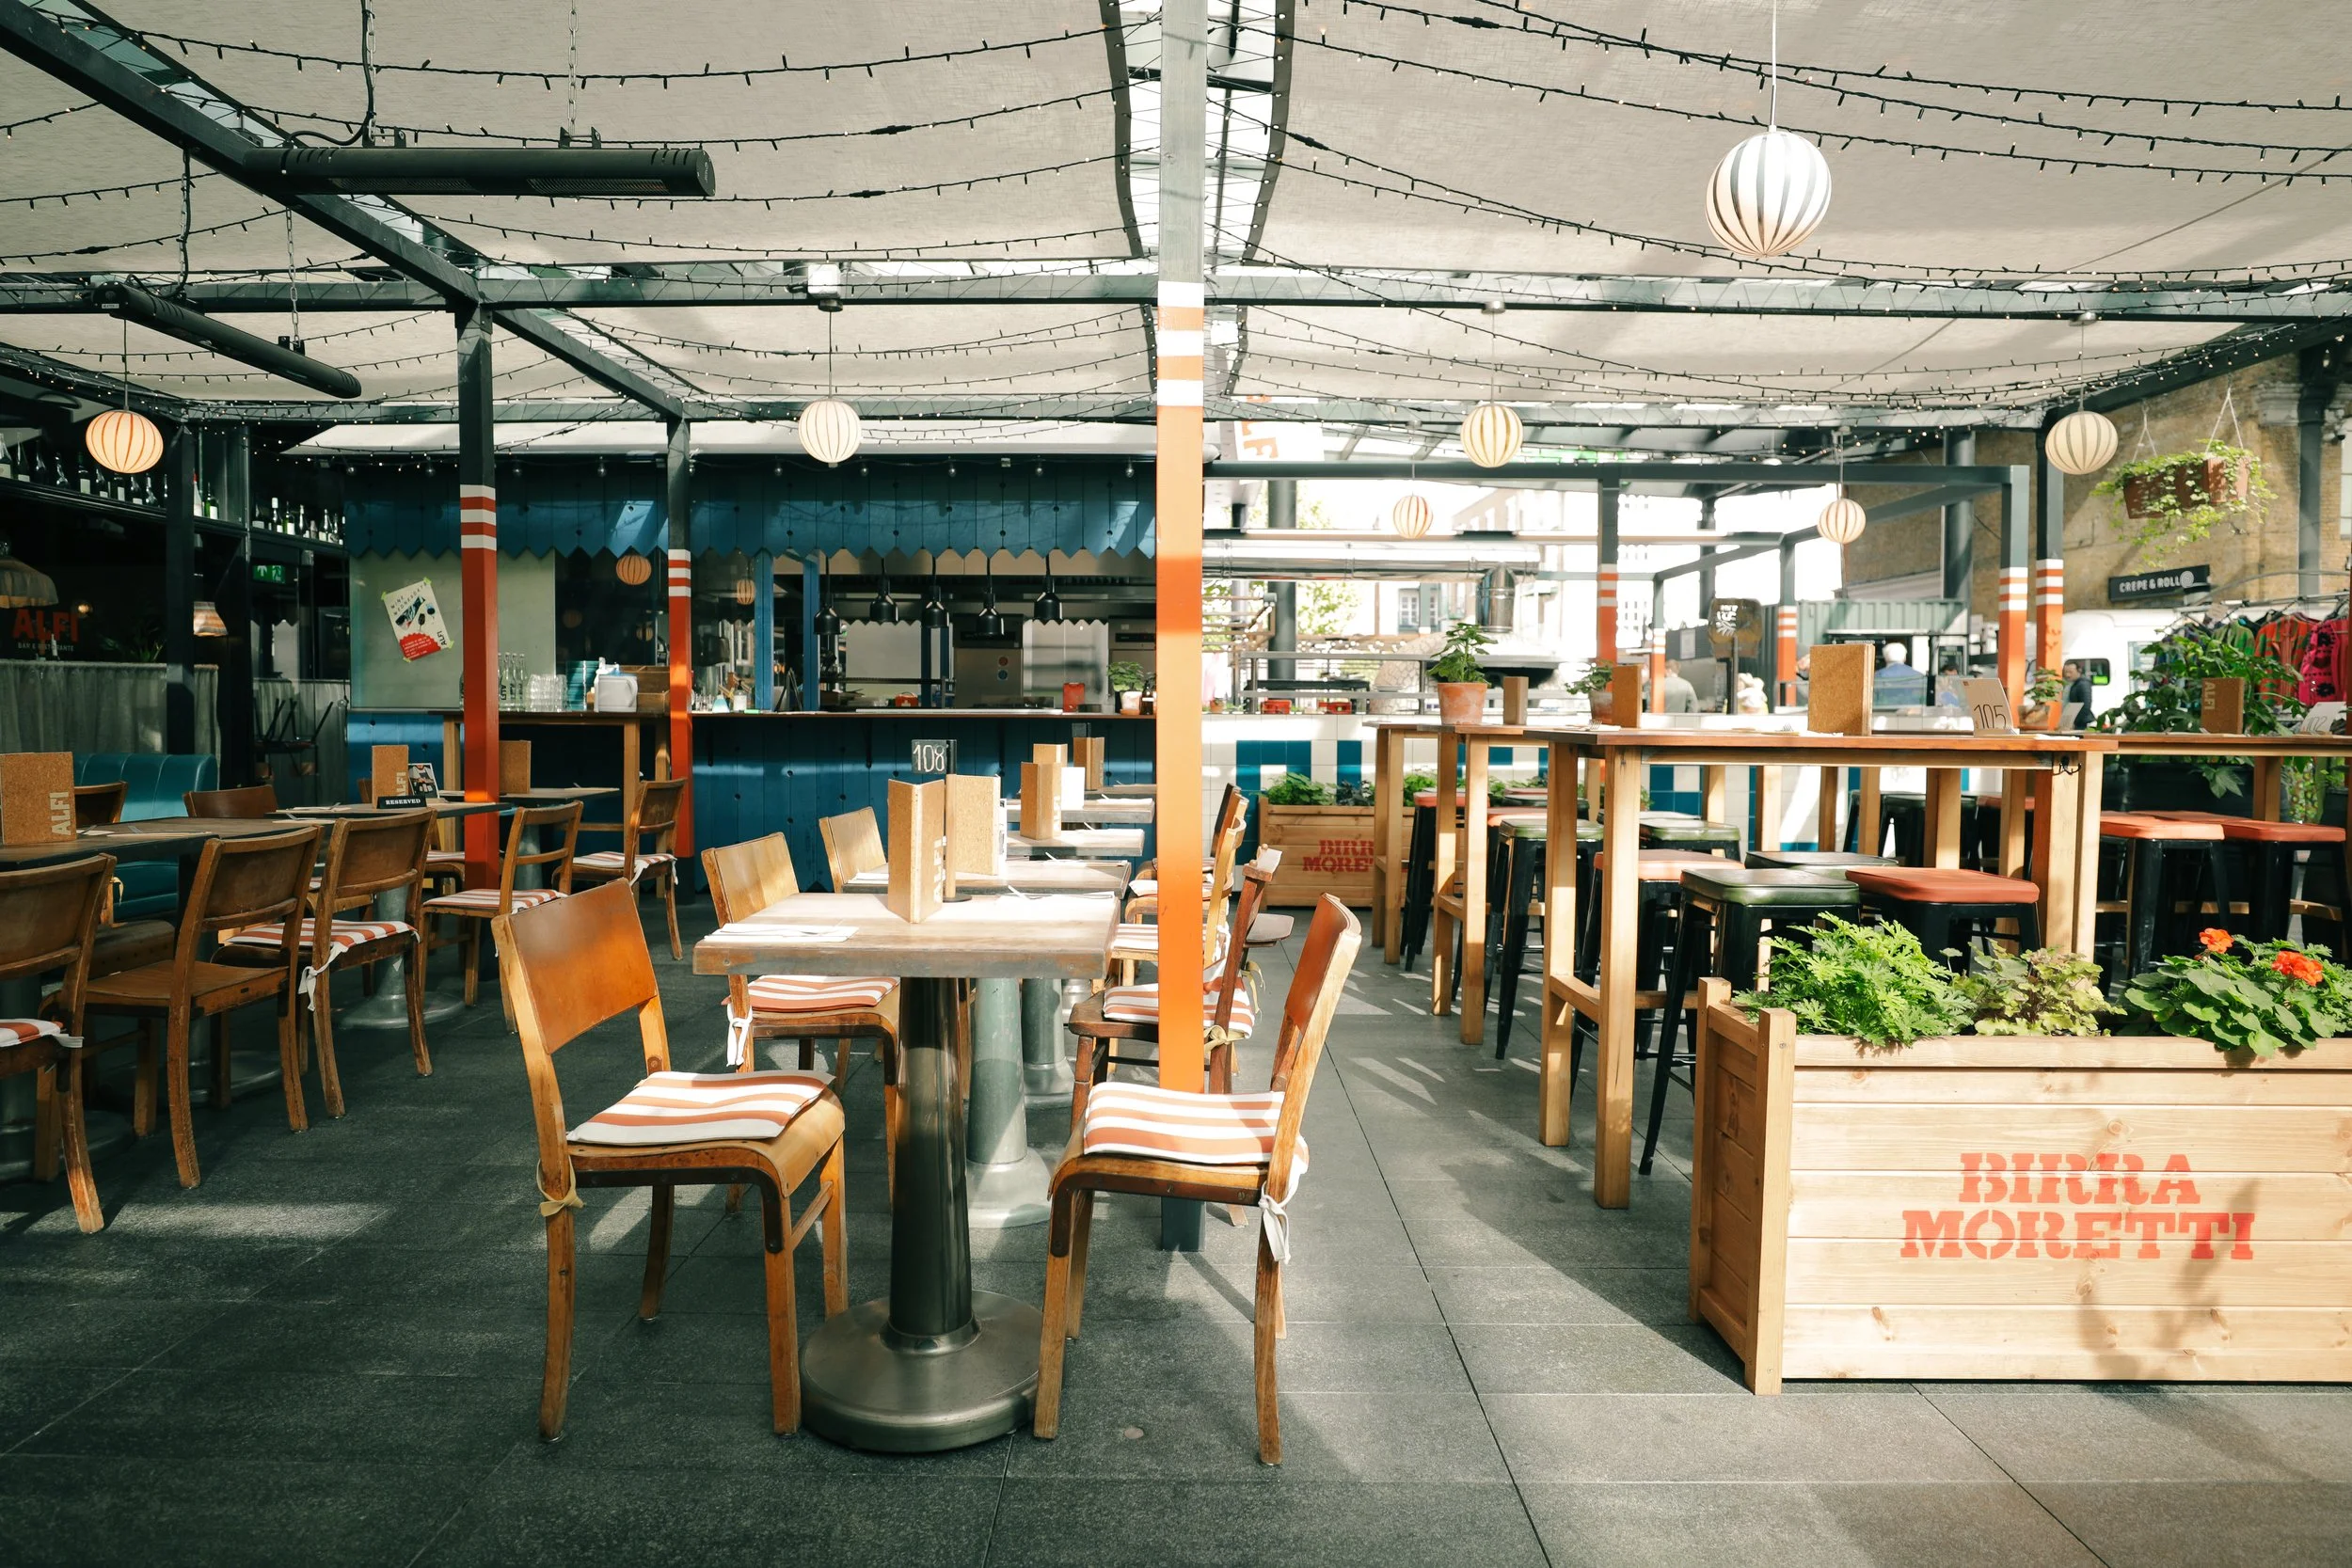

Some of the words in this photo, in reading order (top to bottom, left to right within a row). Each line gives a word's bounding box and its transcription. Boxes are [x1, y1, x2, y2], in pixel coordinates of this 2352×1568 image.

[2119, 579, 2148, 593] CREPE
[2148, 578, 2156, 590] &
[2156, 576, 2180, 588] ROLL
[391, 595, 404, 609] WINE
[12, 609, 79, 642] ALFI
[437, 630, 447, 646] ALFI
[2204, 681, 2215, 710] ALFI
[1973, 704, 2007, 729] 105
[913, 744, 946, 773] 108
[49, 791, 72, 835] ALFI
[1318, 839, 1374, 856] BIRR
[1302, 856, 1374, 873] MORE
[1958, 1152, 2201, 1204] BIRRA
[1899, 1209, 2255, 1260] MORETTI
